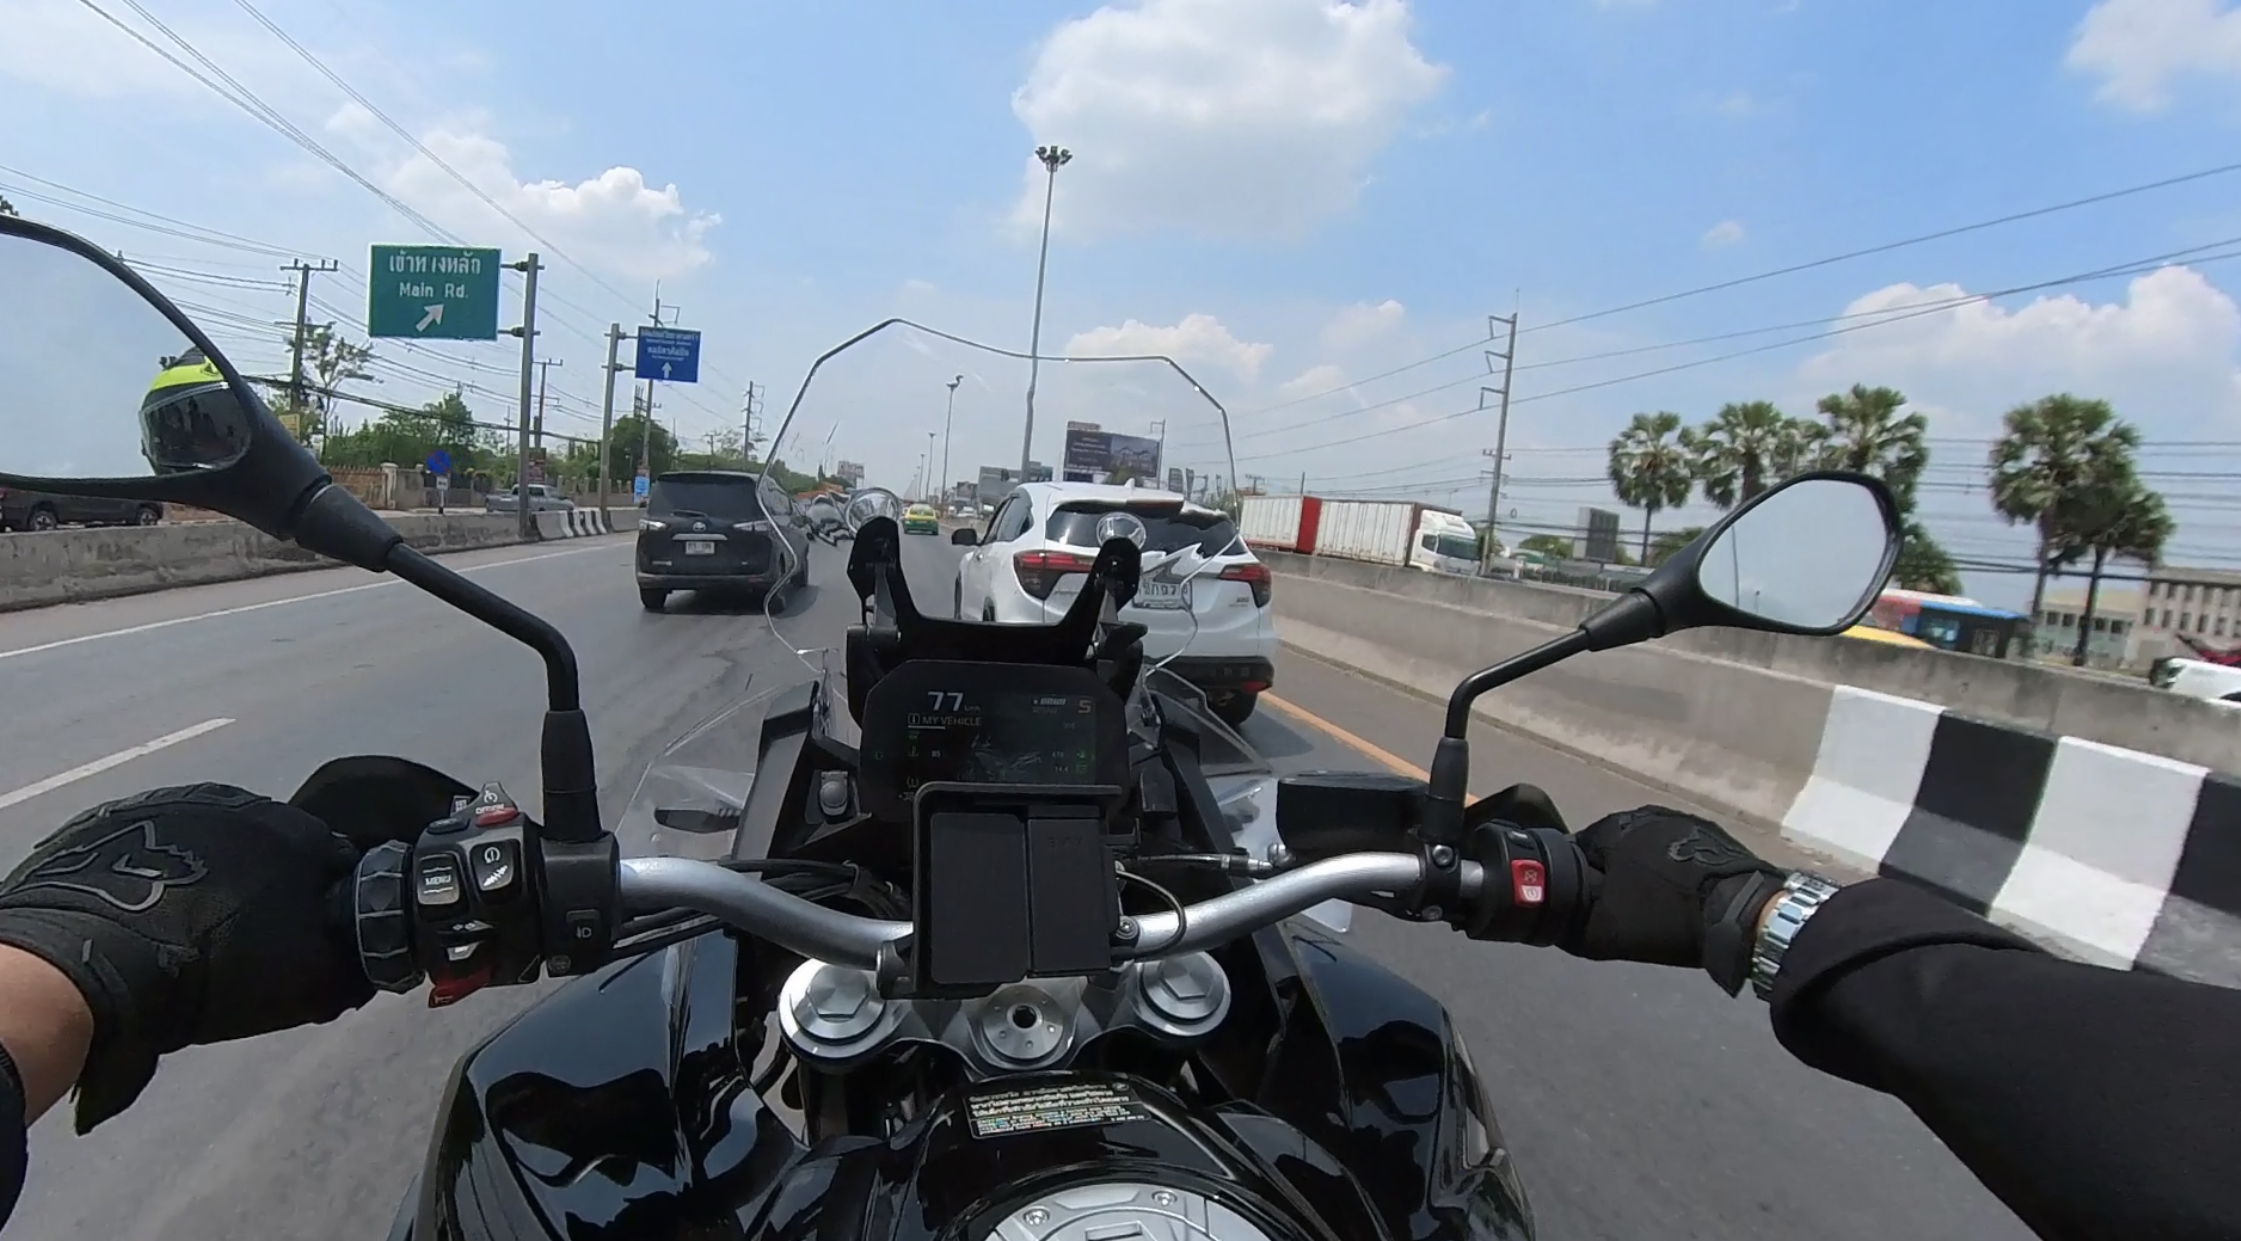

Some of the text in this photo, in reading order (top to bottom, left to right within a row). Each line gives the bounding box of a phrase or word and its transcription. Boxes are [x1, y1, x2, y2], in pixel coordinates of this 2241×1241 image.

[399, 281, 469, 299] Main Rd.
[927, 691, 964, 712] 77
[1077, 699, 1092, 714] S
[922, 715, 982, 726] MY VEHICLE
[424, 873, 451, 886] MENU
